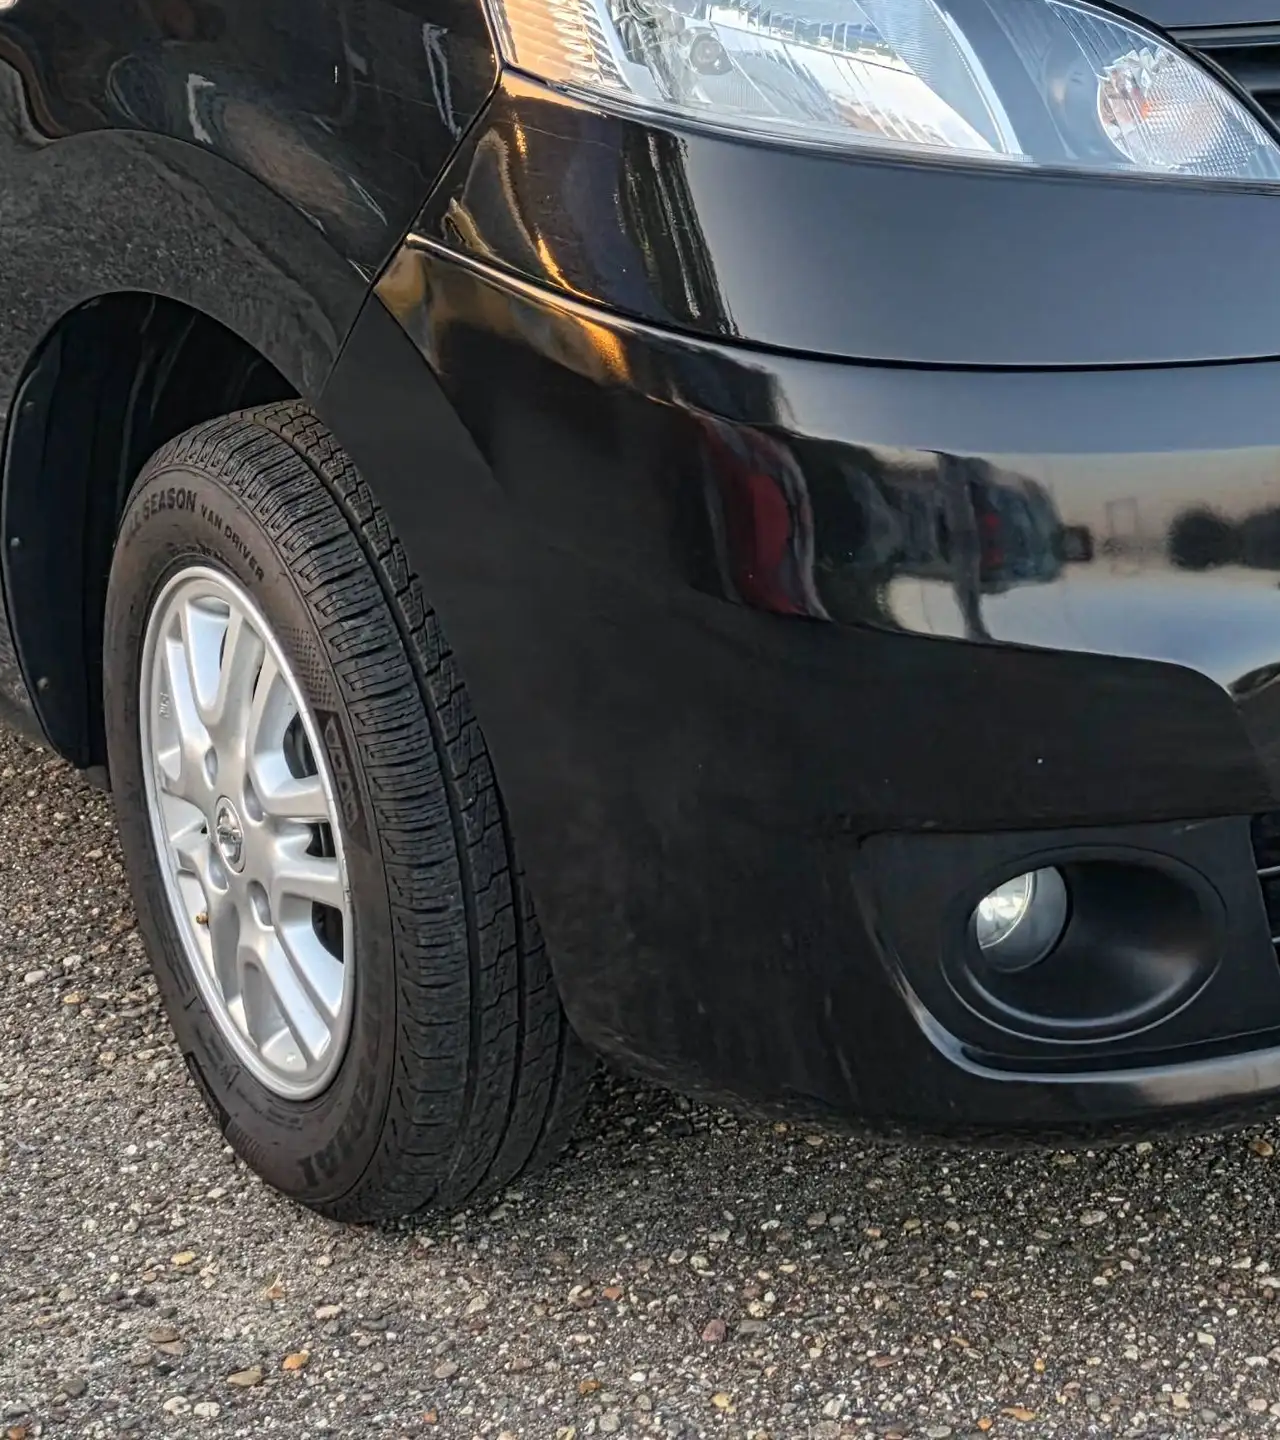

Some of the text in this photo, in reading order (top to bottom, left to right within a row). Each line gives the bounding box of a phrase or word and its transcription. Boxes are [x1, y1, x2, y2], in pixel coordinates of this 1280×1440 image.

[143, 488, 197, 520] SEASON
[201, 504, 222, 530] VAN
[224, 526, 265, 581] DRIVER
